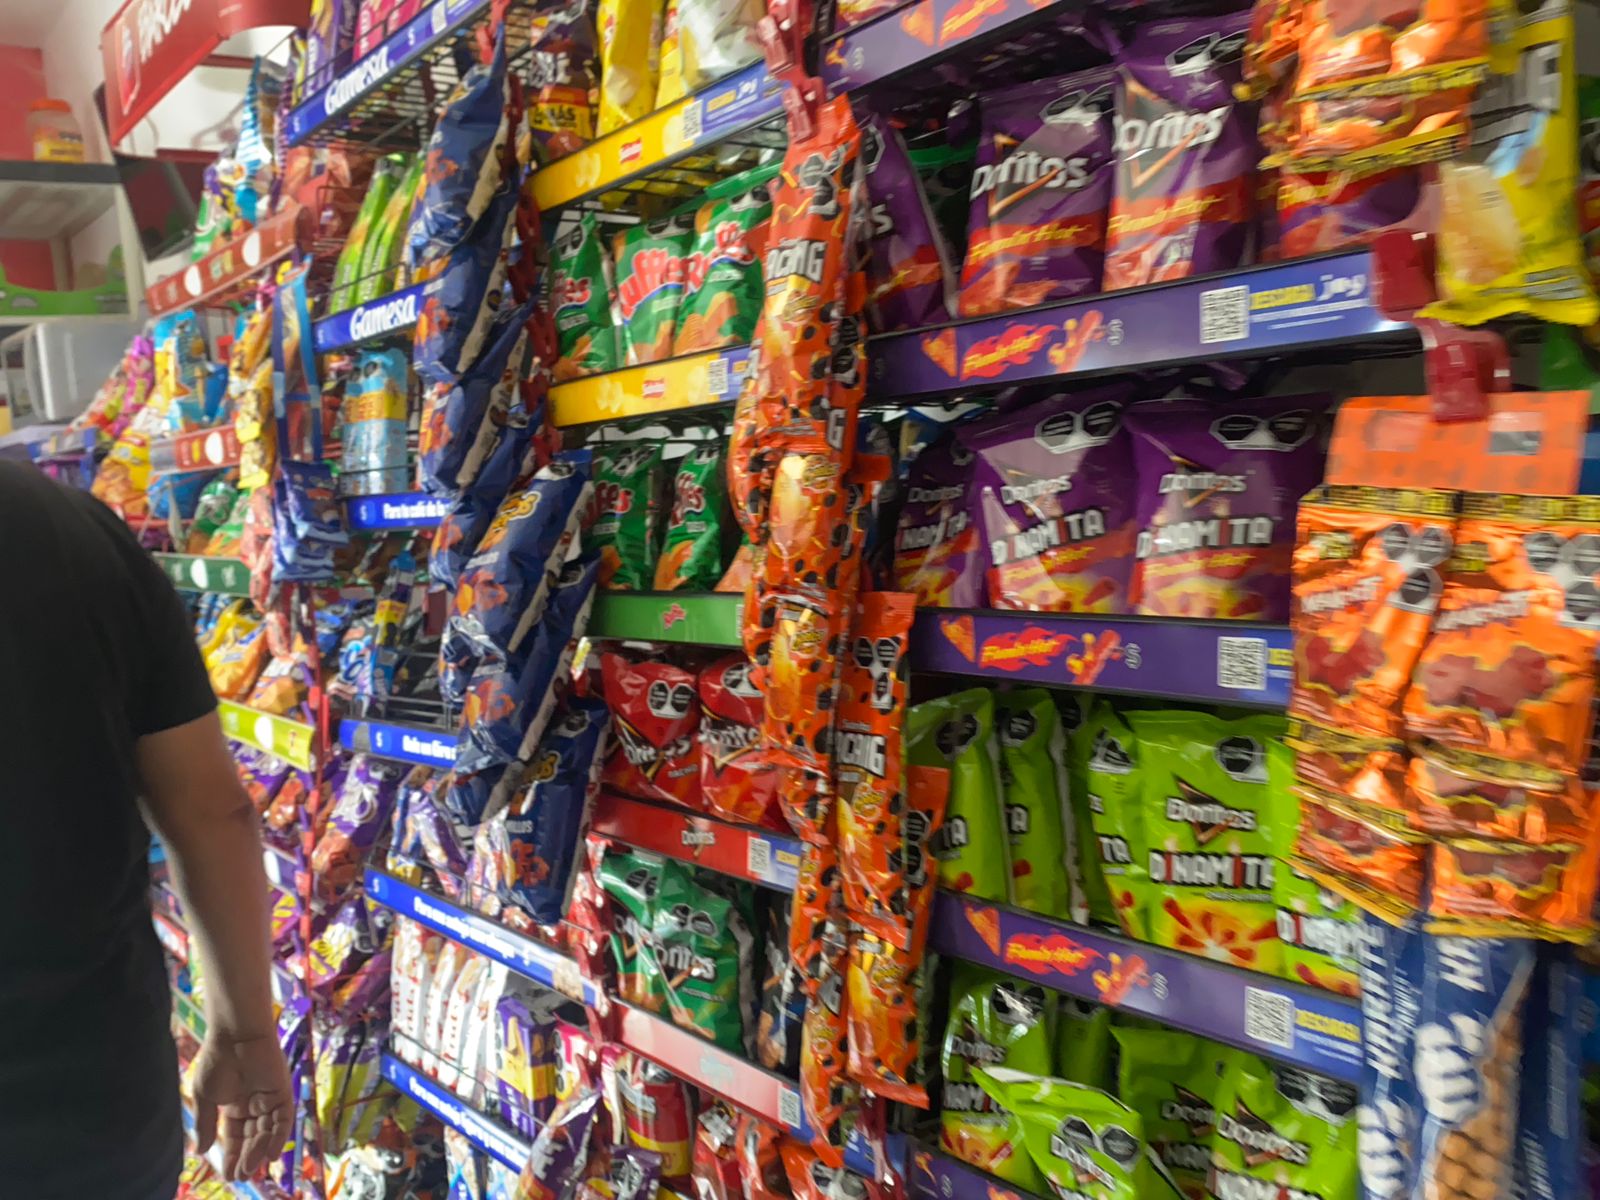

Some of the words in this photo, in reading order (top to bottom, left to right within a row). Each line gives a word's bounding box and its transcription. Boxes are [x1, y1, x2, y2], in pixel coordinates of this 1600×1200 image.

[325, 46, 389, 116] Gamesa
[970, 151, 1091, 200] Doritos
[350, 294, 416, 341] Gamesa
[1159, 473, 1248, 494] Doritos
[1166, 797, 1256, 831] Doritos
[1217, 1112, 1311, 1166] Doritos
